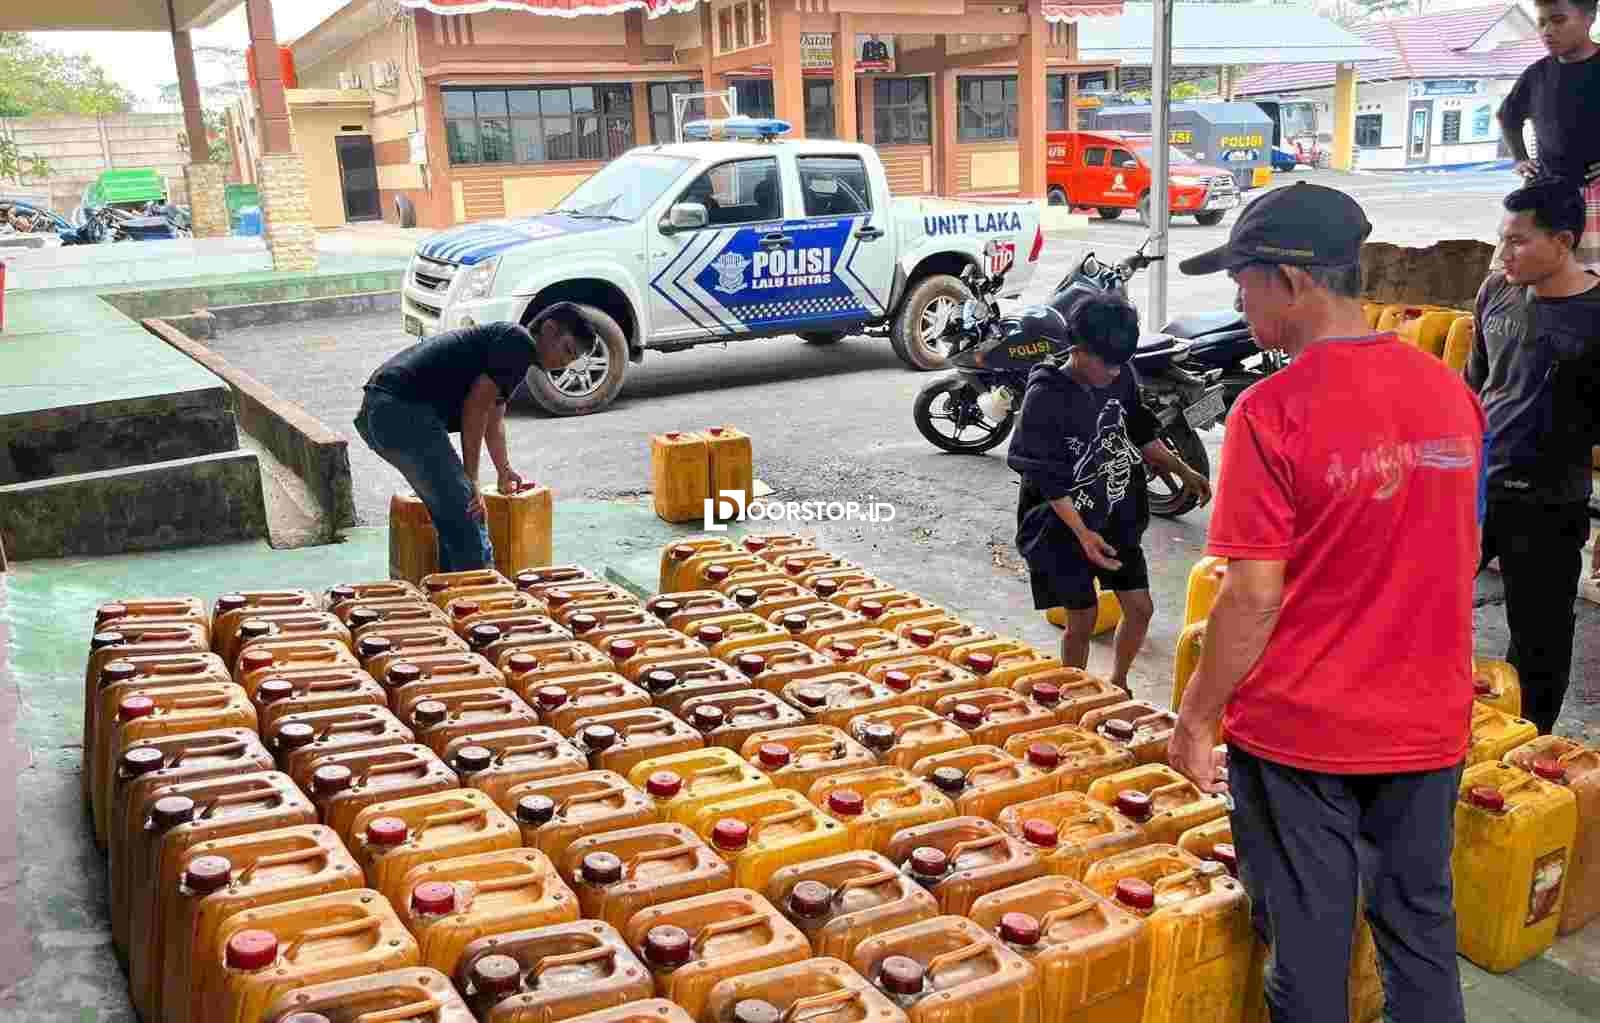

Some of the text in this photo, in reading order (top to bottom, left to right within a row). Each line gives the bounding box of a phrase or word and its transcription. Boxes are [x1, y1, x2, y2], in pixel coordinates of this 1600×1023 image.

[924, 210, 1022, 236] UNIT LAKA
[752, 247, 831, 278] POLISI
[751, 273, 832, 290] LALU LINTAS
[1007, 341, 1049, 360] POLISI
